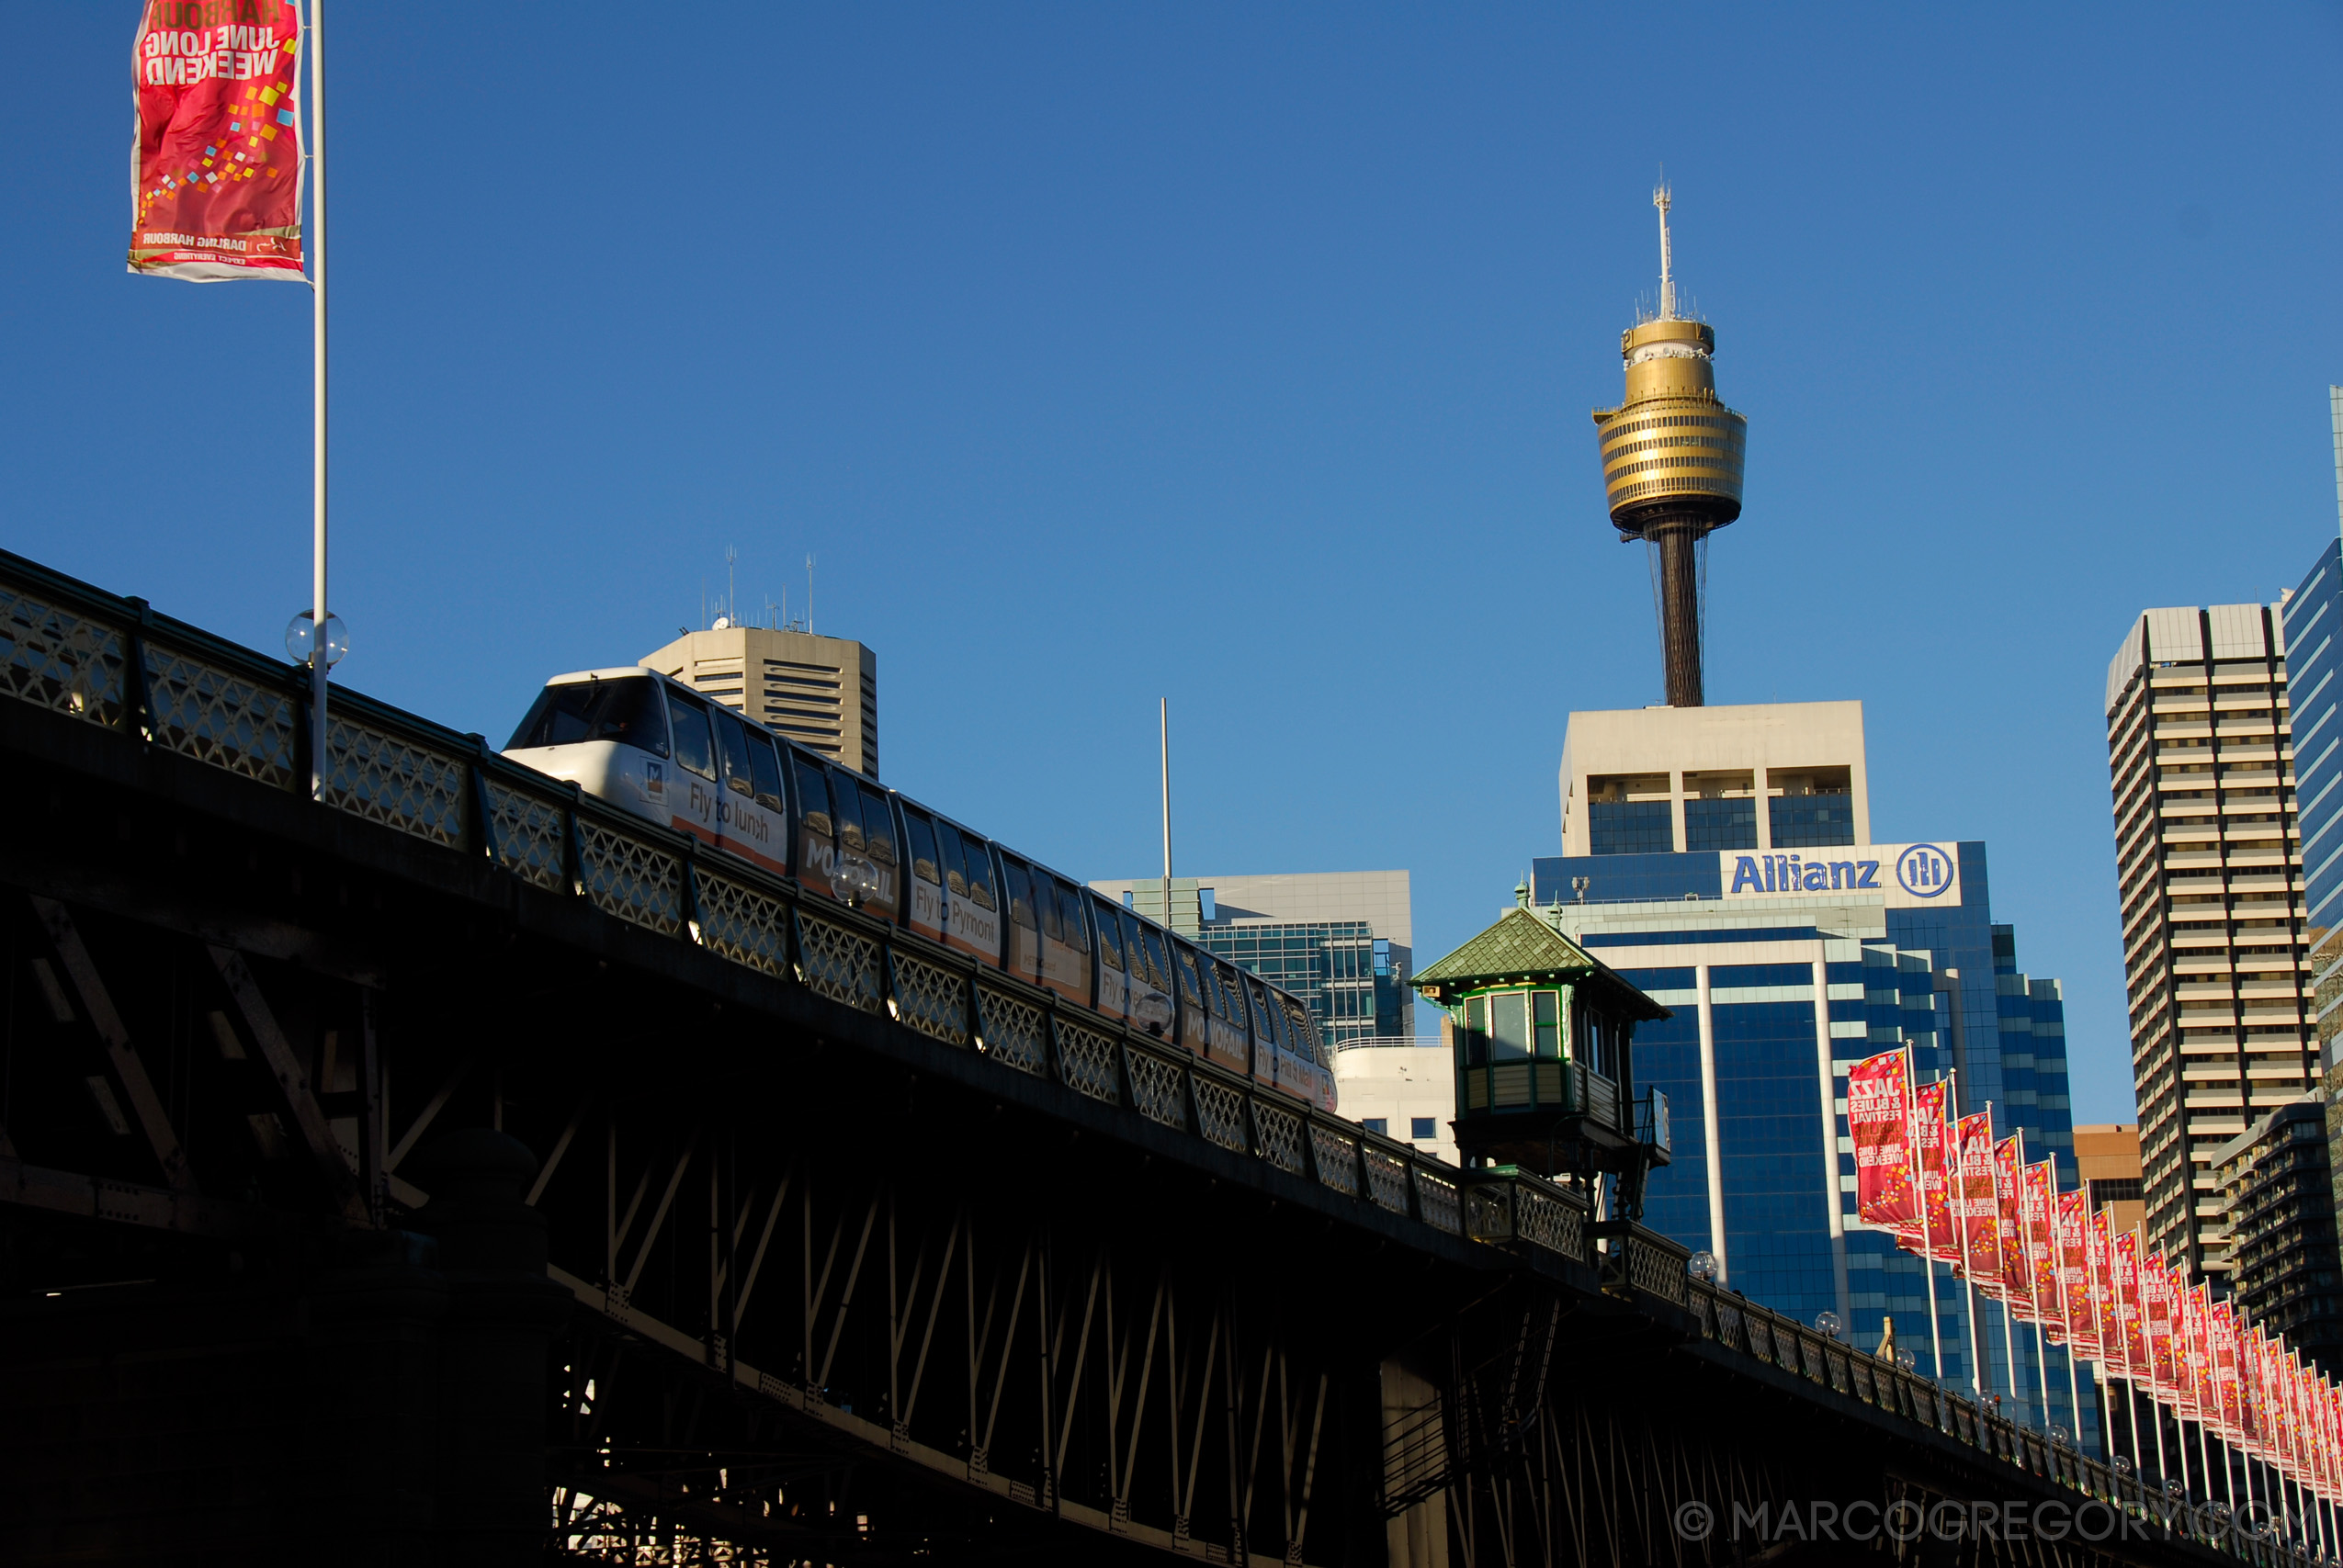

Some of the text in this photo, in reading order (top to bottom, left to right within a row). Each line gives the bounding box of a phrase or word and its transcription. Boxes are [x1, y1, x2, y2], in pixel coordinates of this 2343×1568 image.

[690, 782, 769, 843] Fly to lunch
[1730, 854, 1882, 894] Allianz
[916, 886, 995, 944] Fly to Pyrmont
[1104, 972, 1118, 1005] Fly
[1258, 1044, 1269, 1074] Fly
